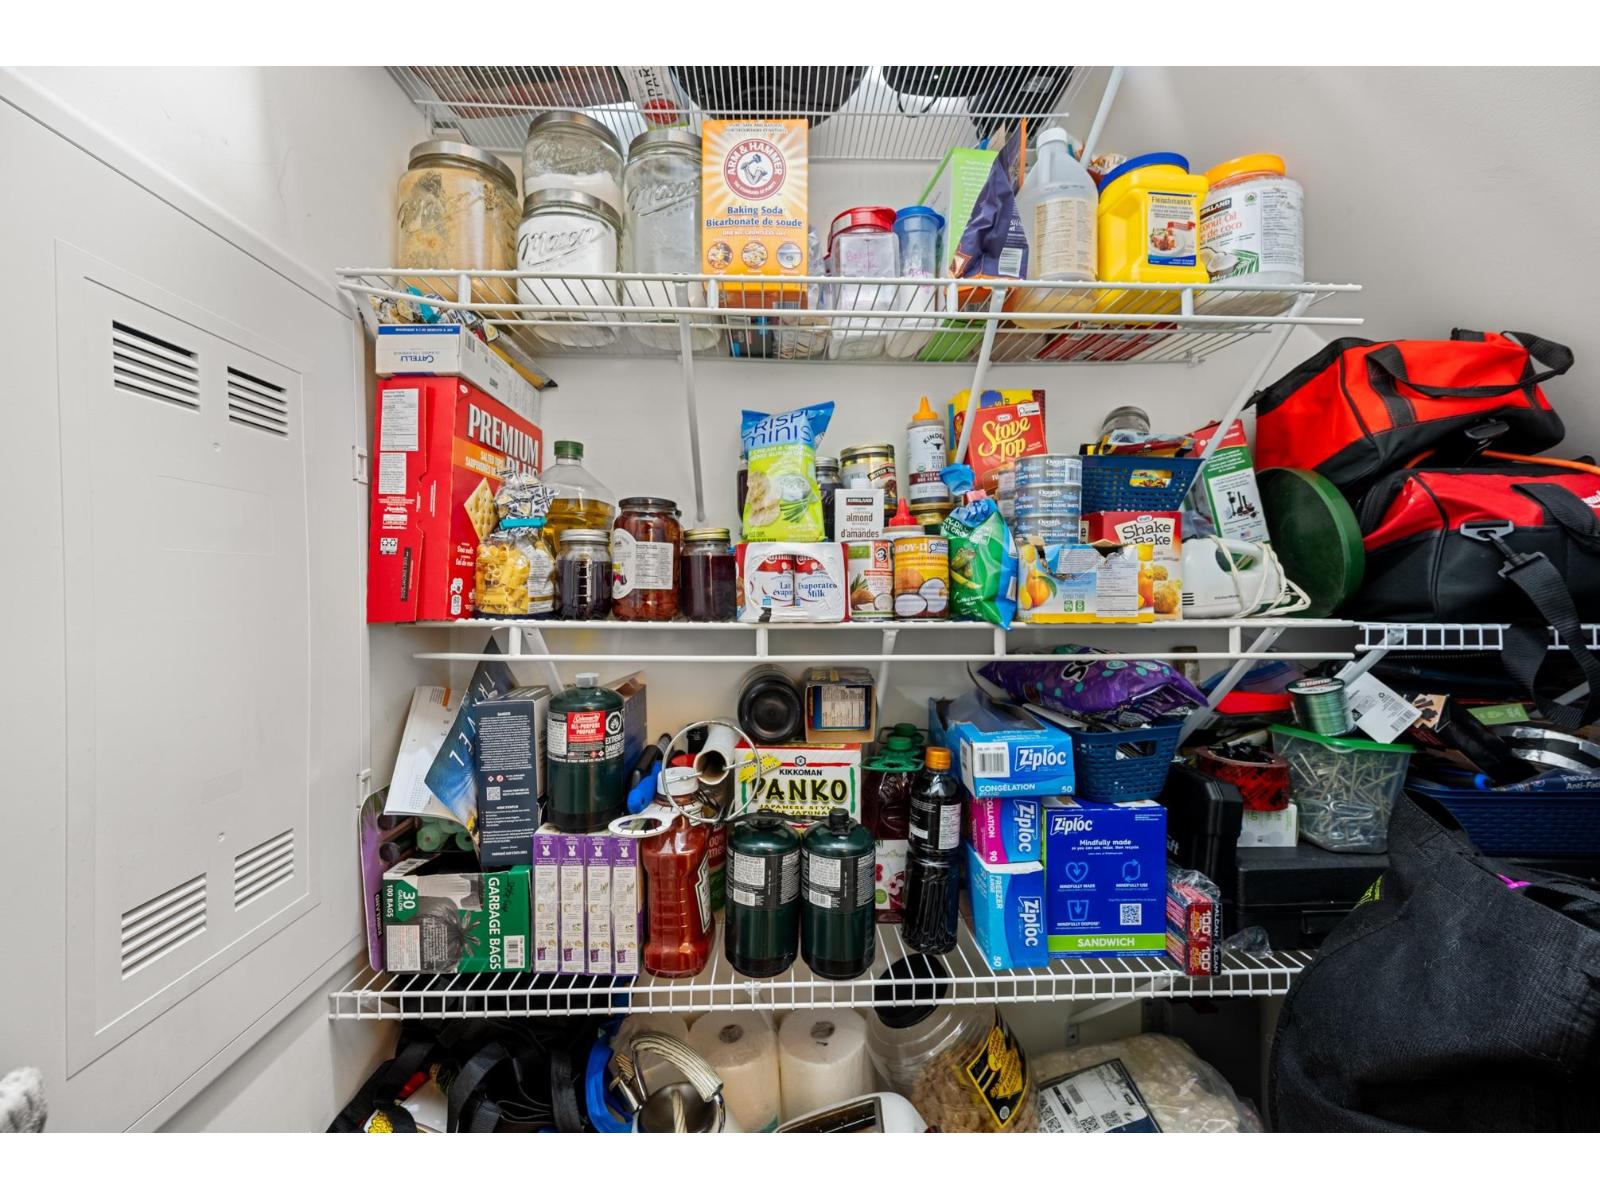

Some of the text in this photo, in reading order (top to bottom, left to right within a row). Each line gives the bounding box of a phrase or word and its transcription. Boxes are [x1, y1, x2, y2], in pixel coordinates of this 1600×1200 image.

[727, 141, 783, 176] ARM & HAMMER
[728, 206, 783, 217] Baking Soda
[706, 217, 802, 227] Bicarbonate de soude
[1220, 222, 1242, 233] coco
[518, 226, 598, 262] Mason
[468, 403, 539, 468] PREMIUM
[978, 416, 1032, 457] Stove
[1000, 438, 1026, 464] Top
[846, 512, 873, 522] almond
[841, 529, 880, 539] d'amandes
[1122, 521, 1171, 540] Shake
[1019, 748, 1067, 771] Ziploc
[752, 778, 847, 801] PANKO
[979, 783, 1073, 793] CONGÉLATION 50
[1015, 804, 1035, 852] Ziploc
[1055, 817, 1093, 835] Ziploc
[989, 851, 998, 862] 90
[386, 884, 394, 897] 100
[994, 875, 1003, 909] FREEZER
[403, 891, 416, 910] 30
[488, 877, 501, 970] GARBAGE BAGS
[1020, 900, 1038, 947] Ziploc
[1077, 937, 1135, 948] SANDWICH
[992, 955, 1001, 967] 50
